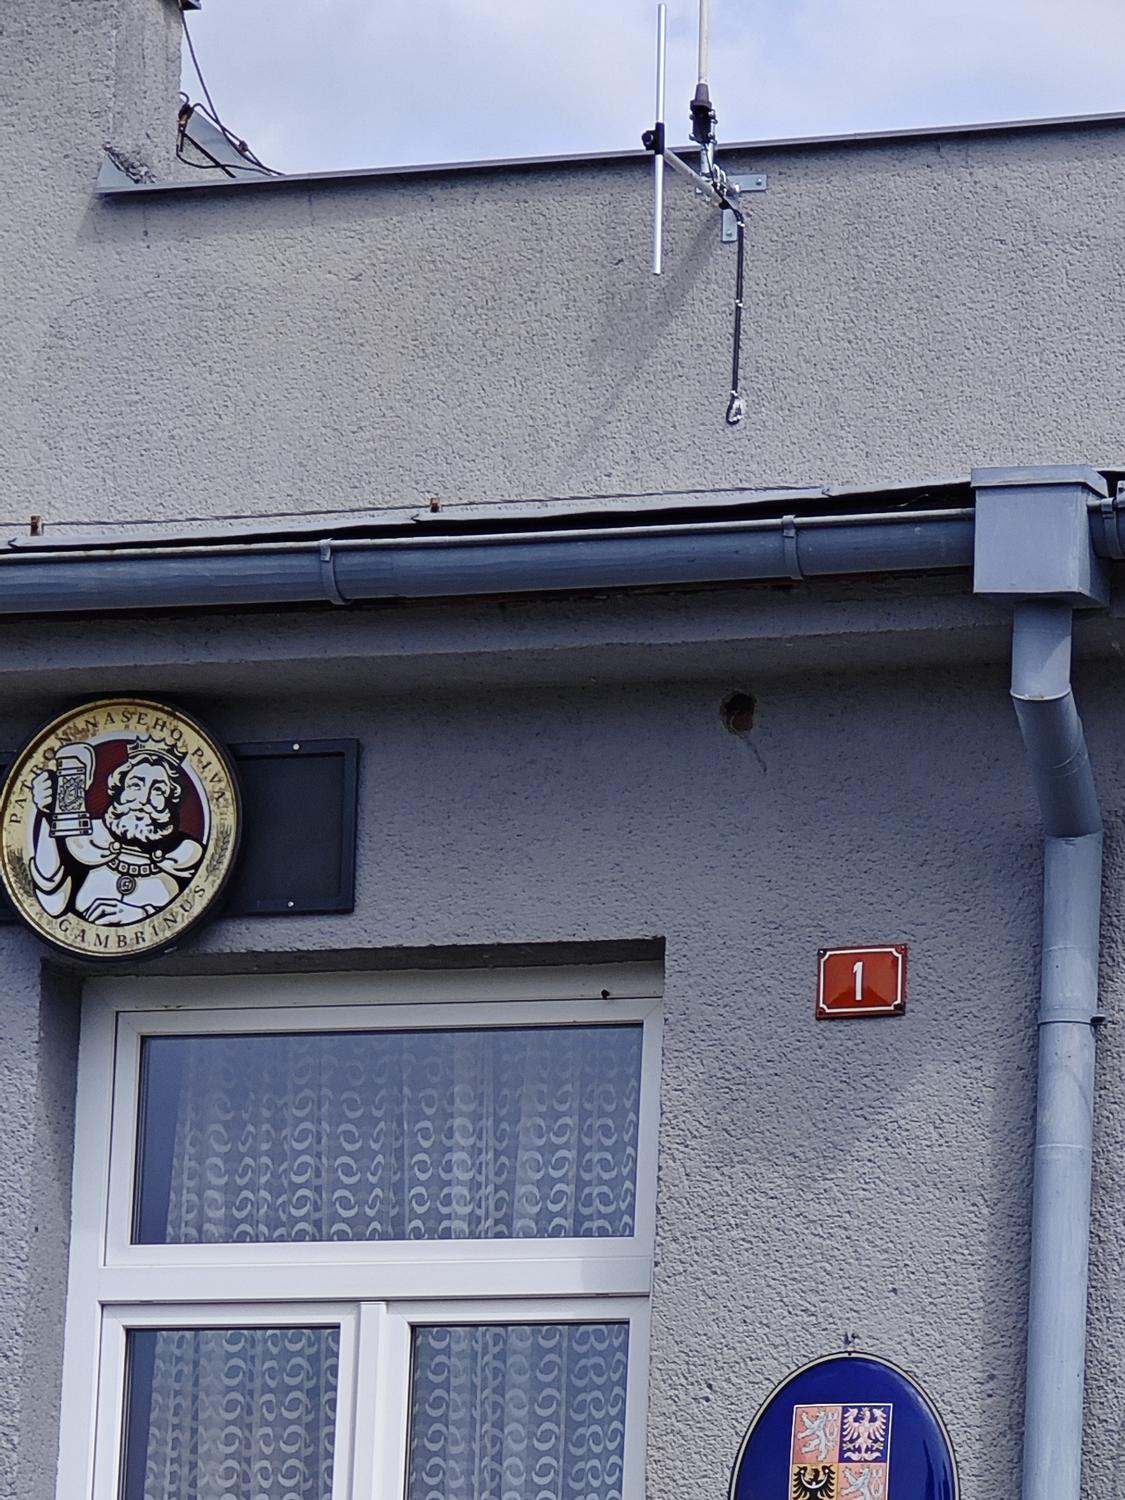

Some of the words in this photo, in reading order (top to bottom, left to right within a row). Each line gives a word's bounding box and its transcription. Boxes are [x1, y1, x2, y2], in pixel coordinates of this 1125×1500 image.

[192, 747, 226, 801] PIVA
[58, 884, 206, 948] GAMBRINUS
[852, 961, 863, 1001] 1
